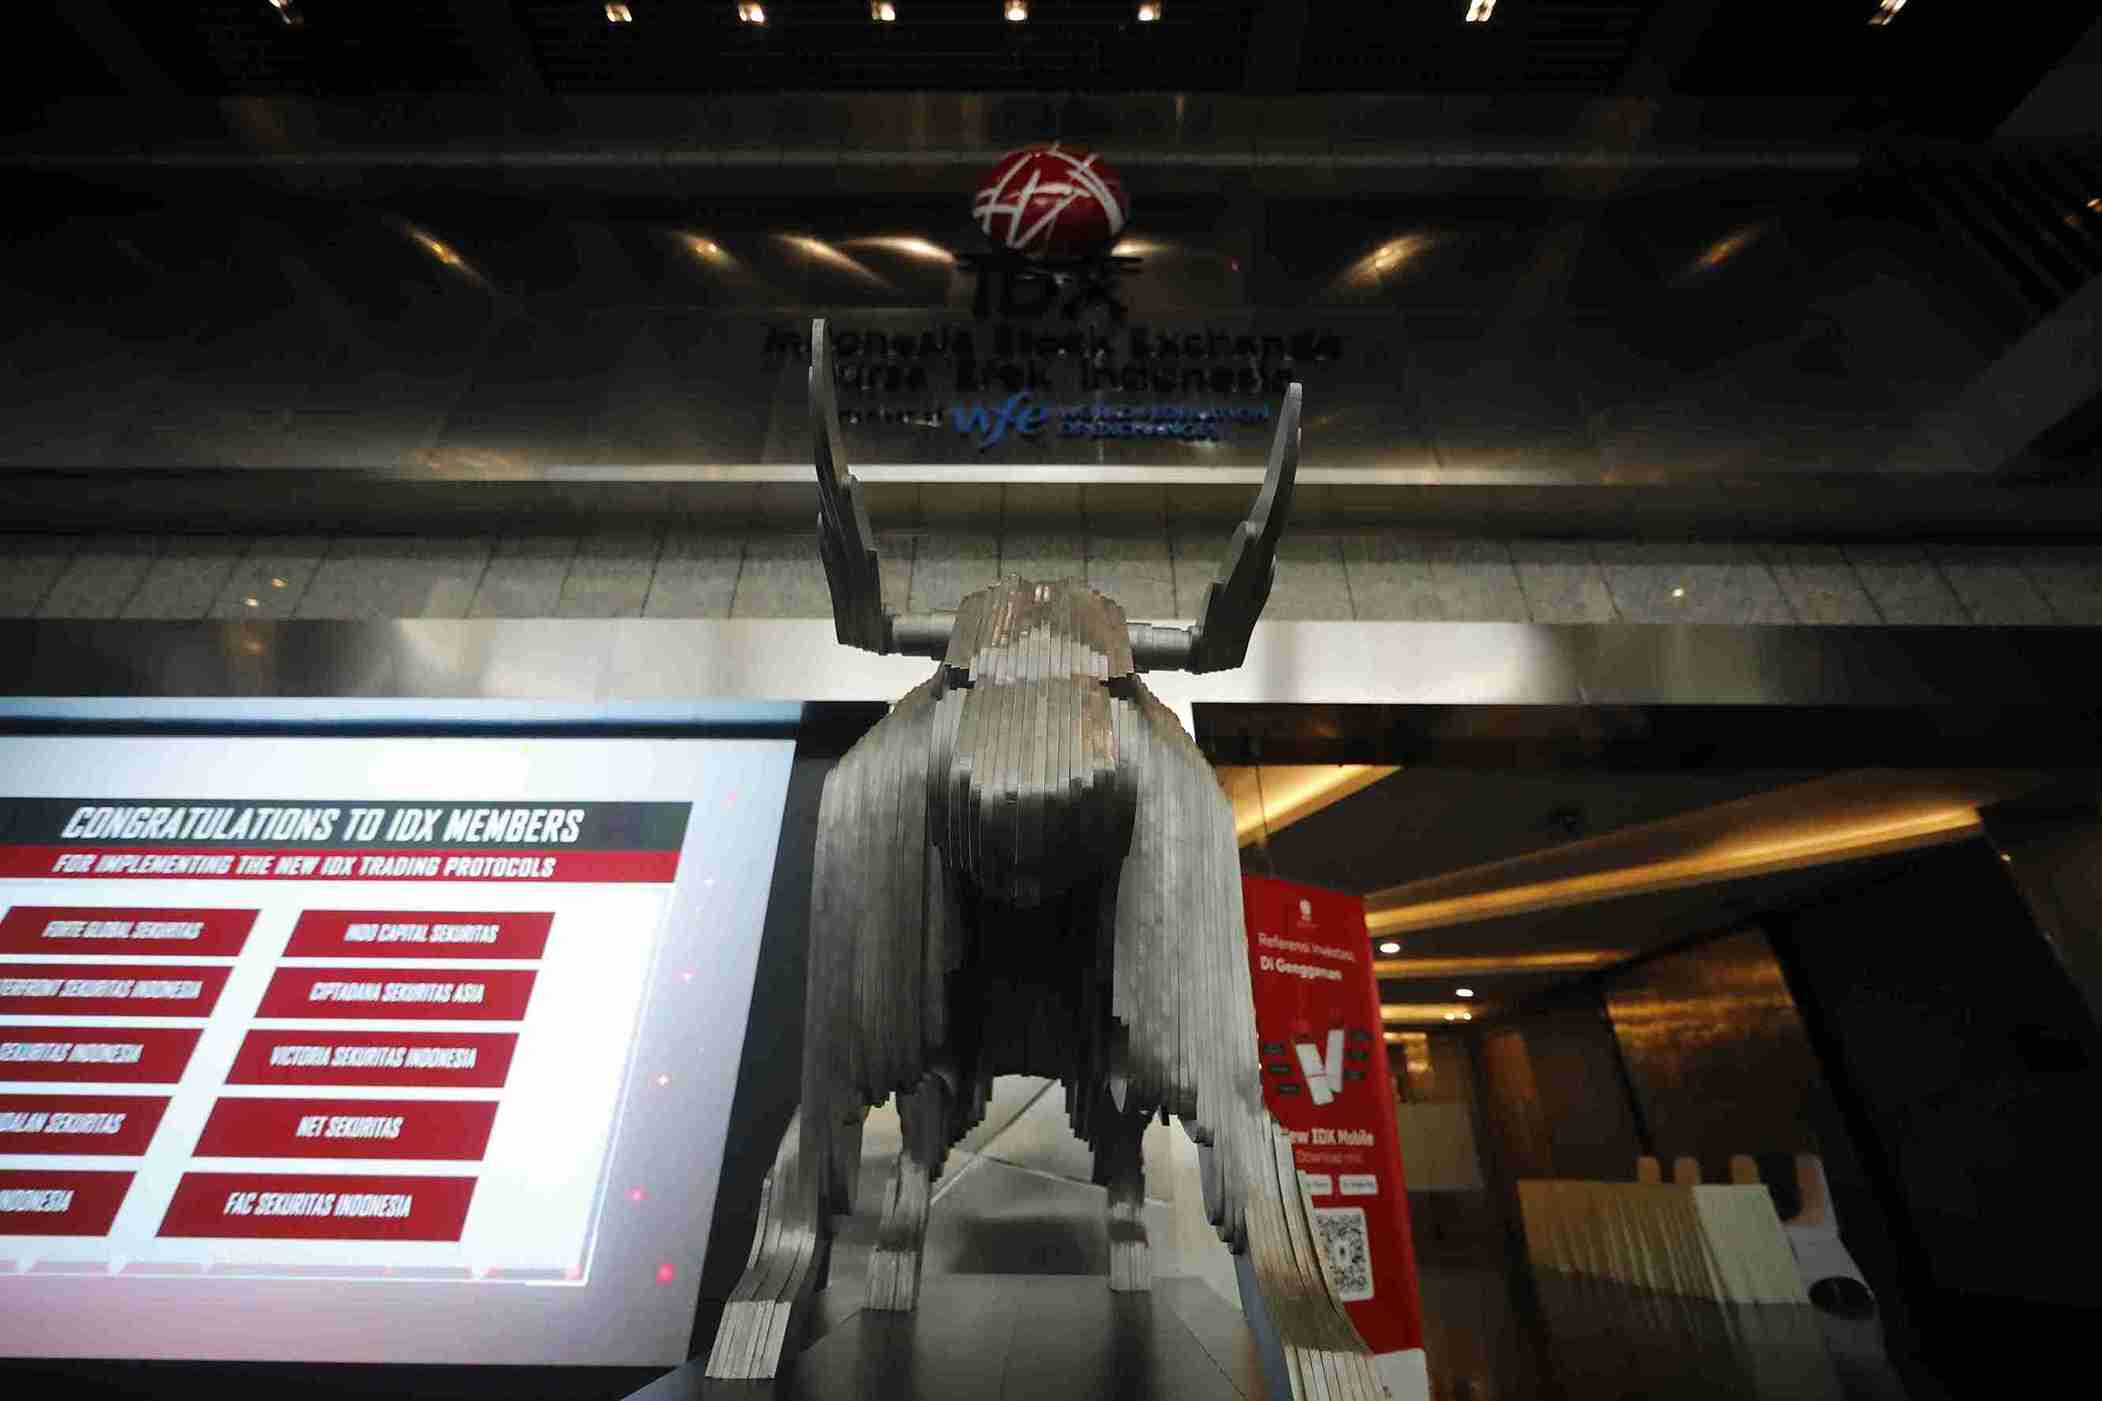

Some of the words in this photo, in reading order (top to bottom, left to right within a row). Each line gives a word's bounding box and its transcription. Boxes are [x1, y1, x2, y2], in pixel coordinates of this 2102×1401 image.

[765, 326, 974, 357] Inonesia
[1131, 328, 1343, 364] Exchange
[832, 362, 926, 392] ursa
[1079, 358, 1292, 394] Indonesia
[61, 806, 340, 841] CONGRATULATIONS
[343, 808, 385, 842] TO
[385, 808, 443, 842] IDX
[443, 808, 585, 843] MEMBERS
[52, 854, 98, 873] FOR
[95, 855, 235, 874] IMPLEMENTING
[235, 856, 276, 875] THE
[274, 856, 321, 875] NEW
[320, 856, 358, 876] IDX
[358, 856, 442, 876] TRADING
[443, 857, 557, 877] PROTOCOLS
[131, 921, 204, 939] SEKURITAS
[376, 923, 429, 942] CAPITAL
[429, 924, 499, 943] SEKURITAS
[1259, 955, 1275, 971] Di
[58, 979, 136, 998] SEKURITAS
[129, 980, 204, 999] INDONESIA
[382, 982, 456, 1003] SEKURITAS
[452, 983, 486, 1003] ASIA
[67, 1043, 144, 1063] INDONESIA
[270, 1045, 333, 1066] VICTORIA
[331, 1046, 407, 1067] SEKURITAS
[404, 1047, 477, 1069] INDONESIA
[43, 1112, 127, 1134] SEKURITAS
[296, 1116, 329, 1137] NET
[325, 1116, 404, 1138] SEKURITAS
[1312, 1128, 1337, 1145] IDX
[1337, 1128, 1375, 1147] Mobile
[224, 1192, 257, 1216] FAC
[254, 1192, 335, 1217] SEKURITAS
[333, 1193, 412, 1218] INDONESIA
